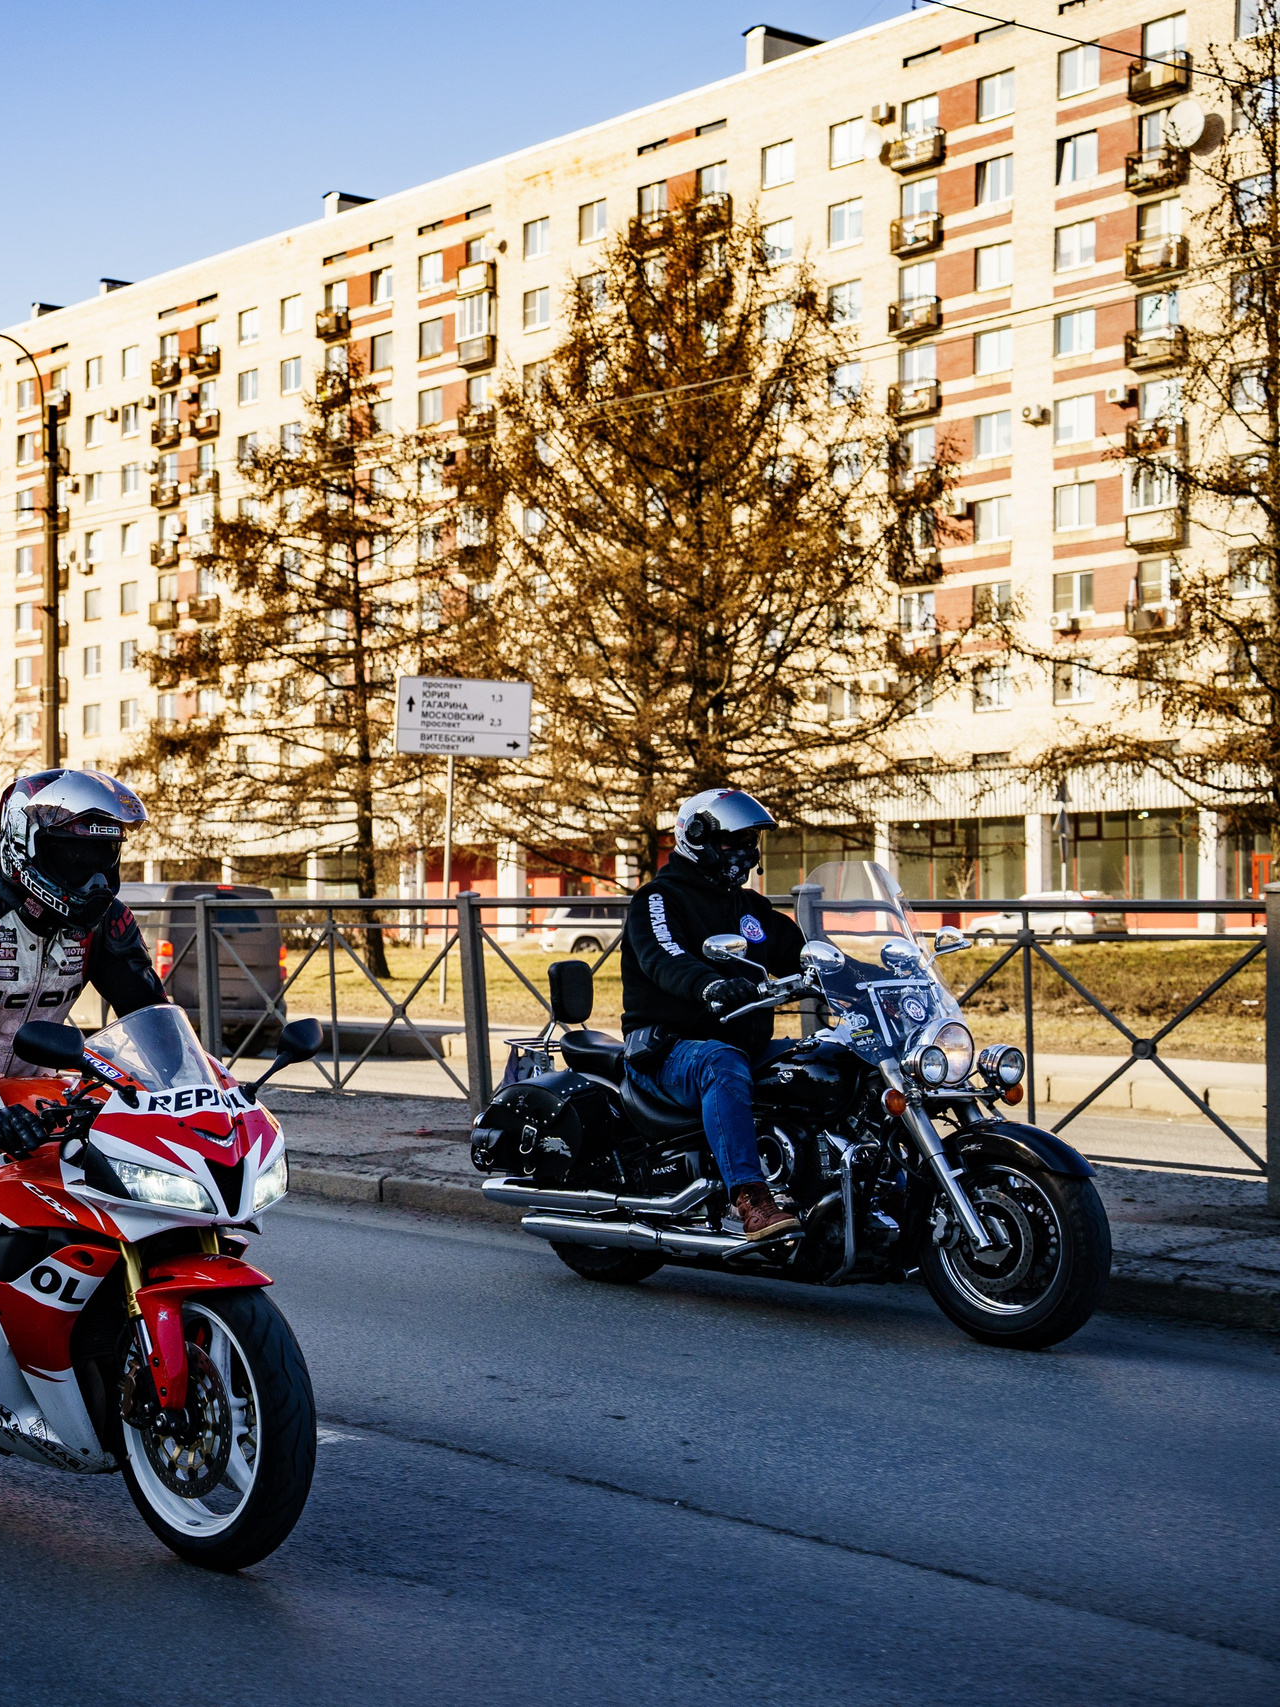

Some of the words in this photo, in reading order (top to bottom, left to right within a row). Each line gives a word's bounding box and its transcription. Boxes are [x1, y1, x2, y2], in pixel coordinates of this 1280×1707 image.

[422, 681, 462, 690] проспект
[422, 690, 450, 698] ЮРИЯ
[491, 694, 503, 702] 1,3
[421, 700, 468, 710] ГАГАРИНА
[421, 711, 484, 721] МОСКОВСКИЙ
[421, 720, 461, 729] проспект
[490, 718, 502, 727] 2,3
[420, 733, 475, 743] ВИТЕБСКИЙ
[420, 743, 460, 751] проспект
[652, 1163, 677, 1176] MARK
[22, 1181, 78, 1223] CBR
